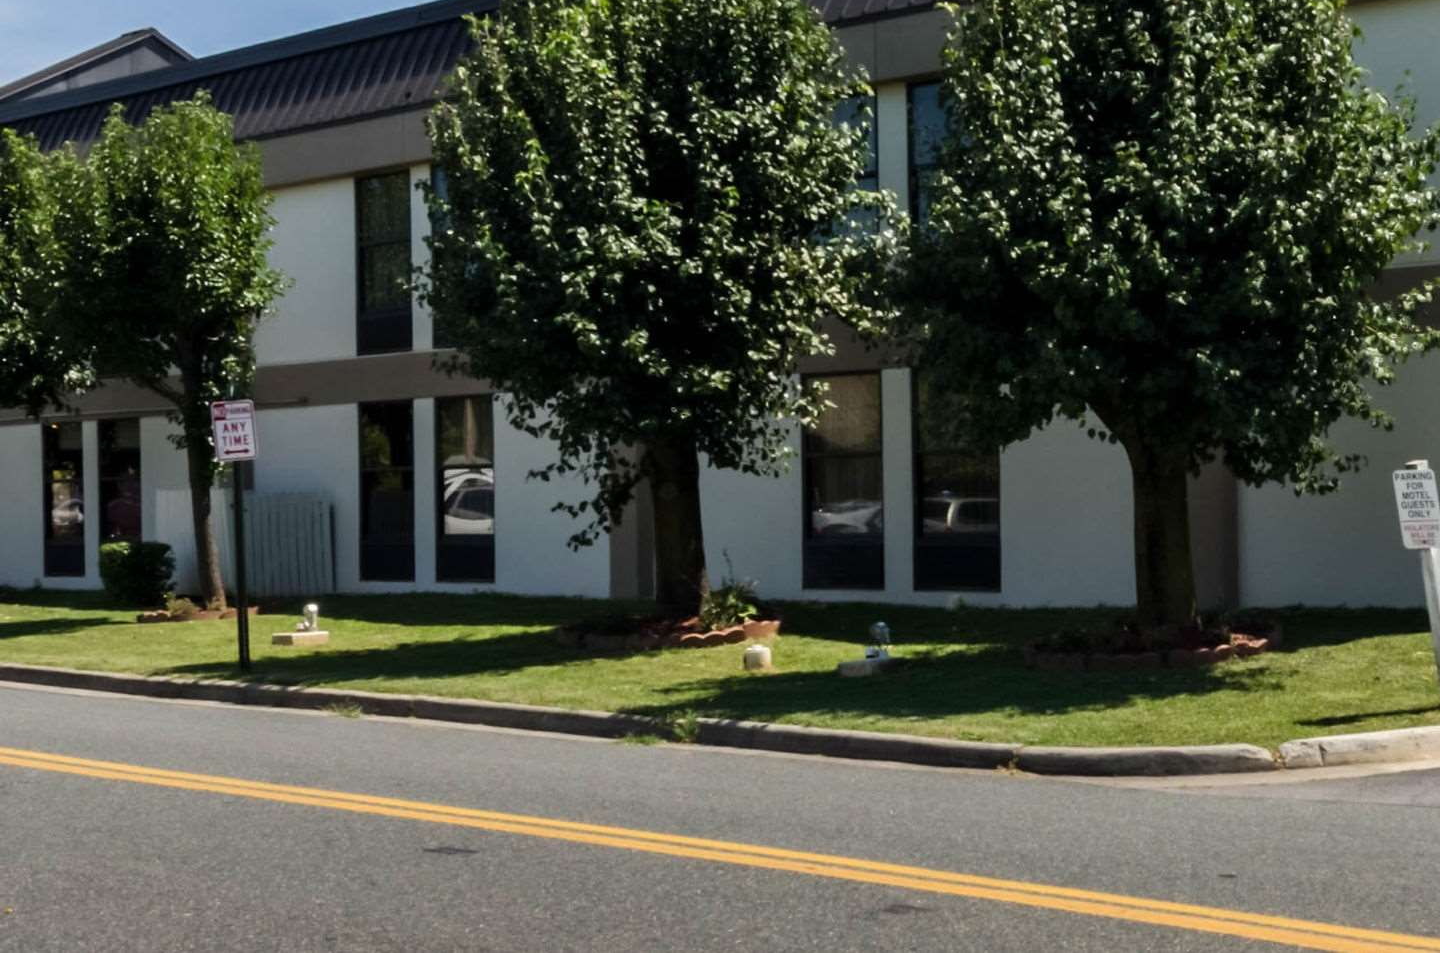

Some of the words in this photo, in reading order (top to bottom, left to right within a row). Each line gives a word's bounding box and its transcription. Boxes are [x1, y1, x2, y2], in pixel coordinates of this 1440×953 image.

[224, 422, 246, 432] ANY
[222, 434, 248, 446] TIME
[1394, 472, 1432, 480] PARKING
[1400, 500, 1436, 509] GUESTS
[1408, 510, 1430, 518] ONLY
